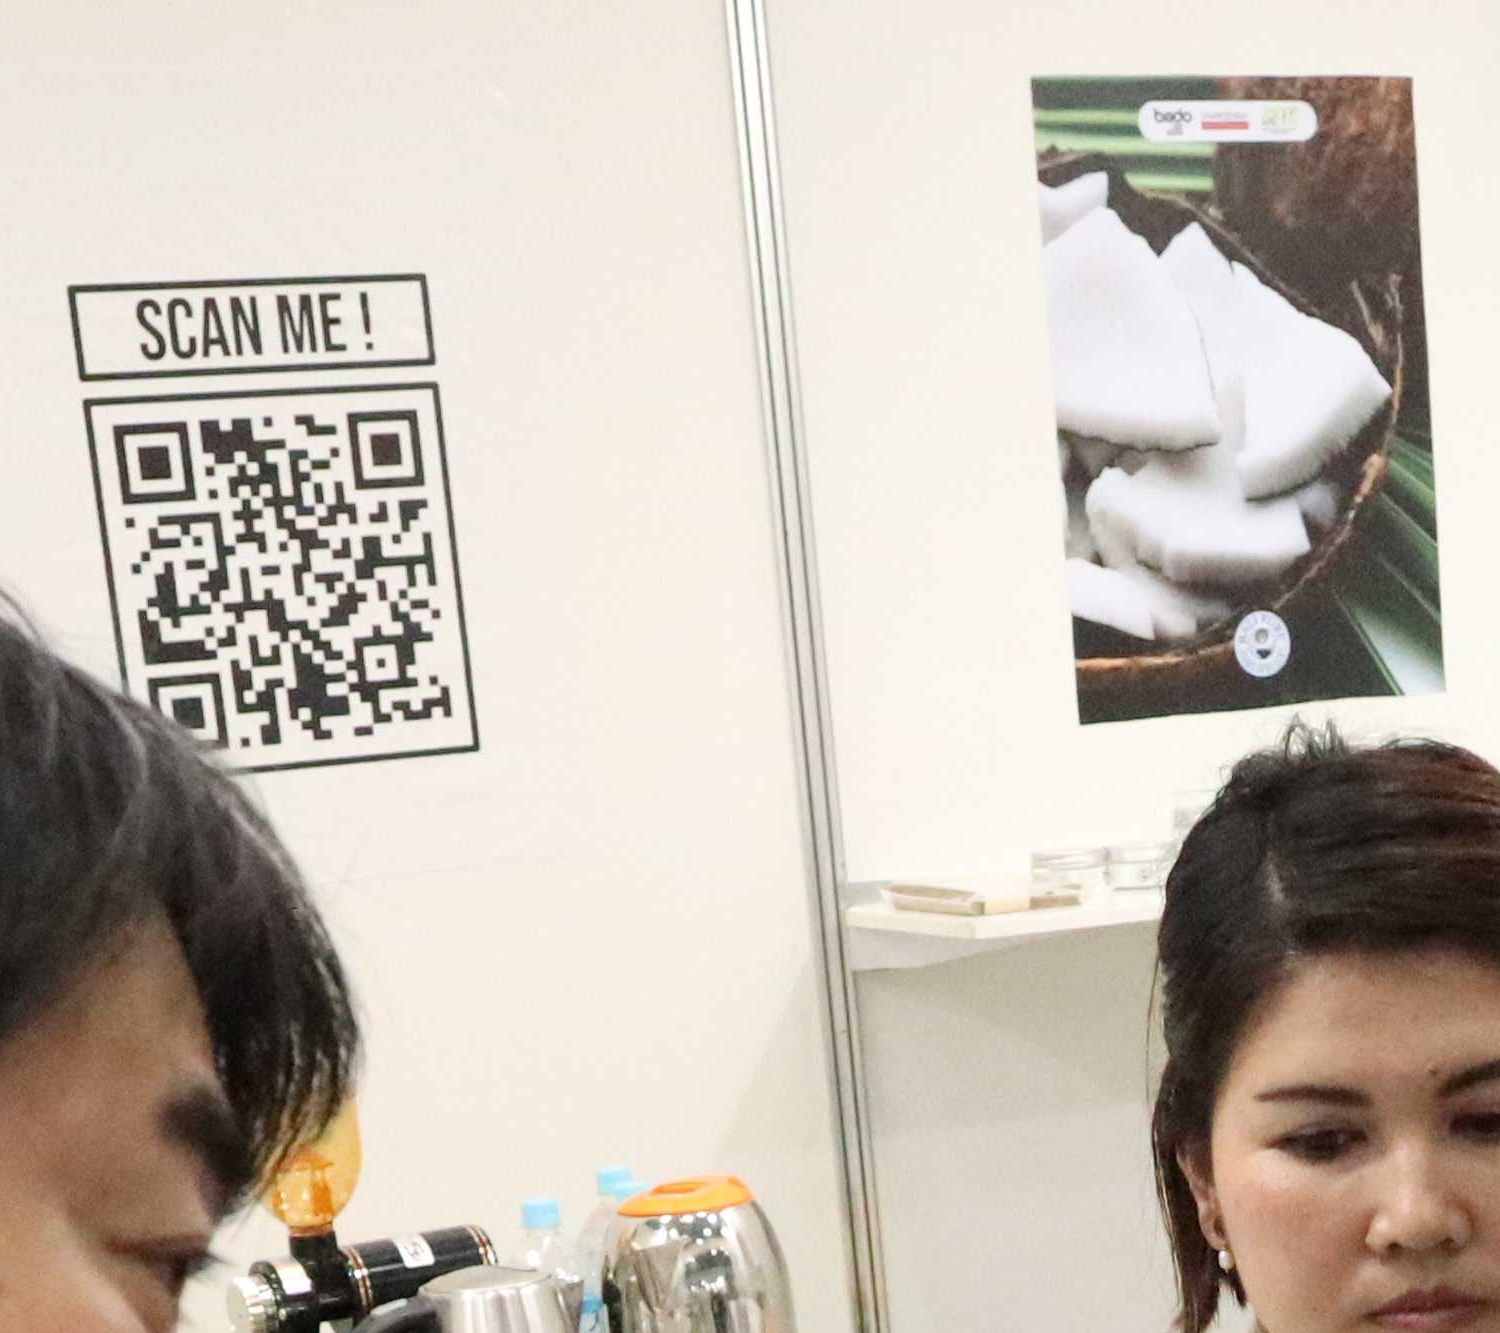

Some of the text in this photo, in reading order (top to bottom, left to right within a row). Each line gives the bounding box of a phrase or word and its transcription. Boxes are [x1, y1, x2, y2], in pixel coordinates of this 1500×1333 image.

[136, 292, 375, 361] SCAN ME !
